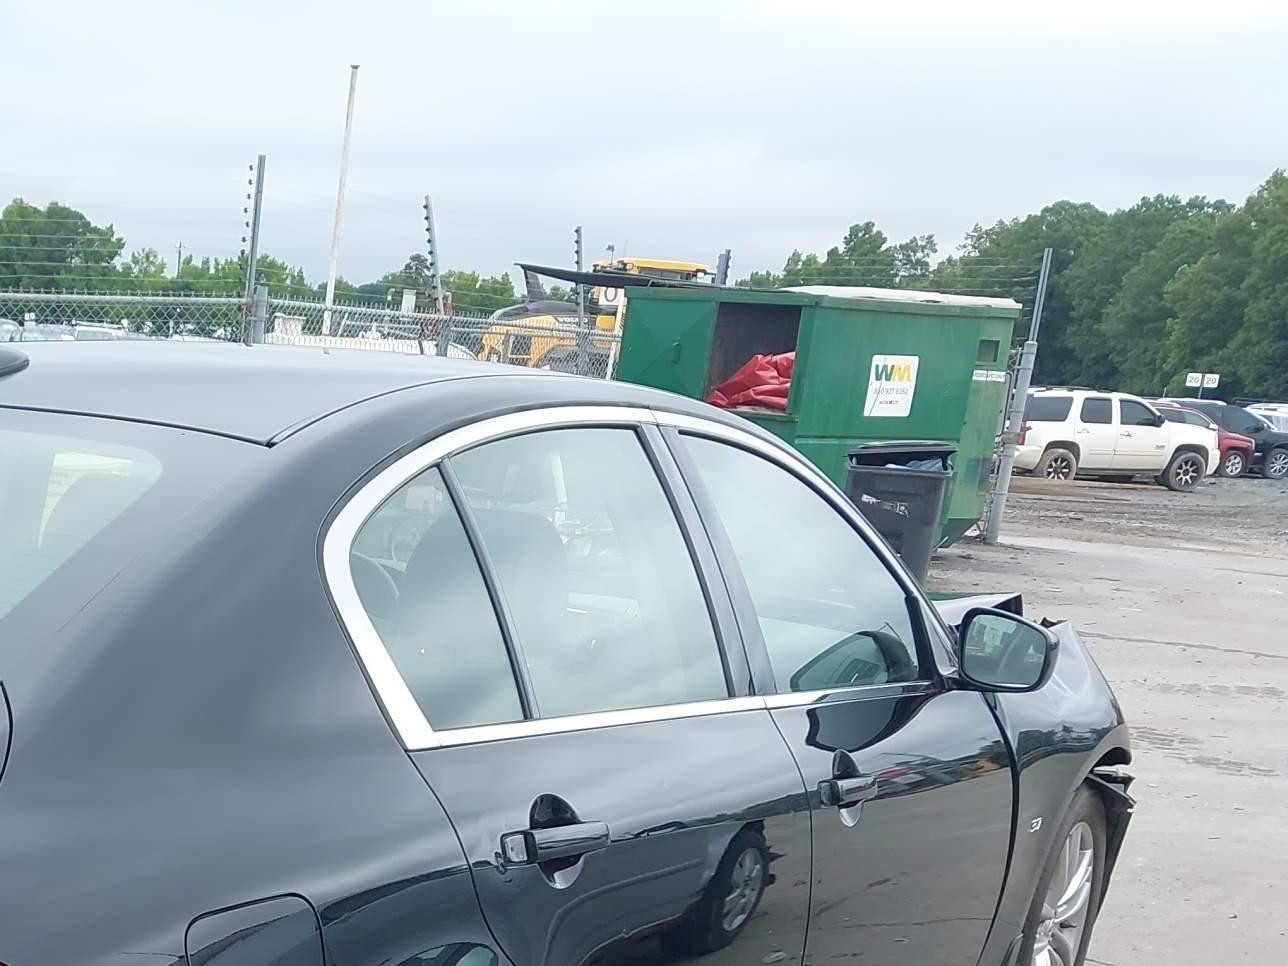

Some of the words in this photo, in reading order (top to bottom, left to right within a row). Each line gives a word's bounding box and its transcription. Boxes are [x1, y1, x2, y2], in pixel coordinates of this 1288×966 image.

[874, 364, 911, 382] WM
[1188, 376, 1200, 384] 20
[1205, 377, 1217, 385] 20
